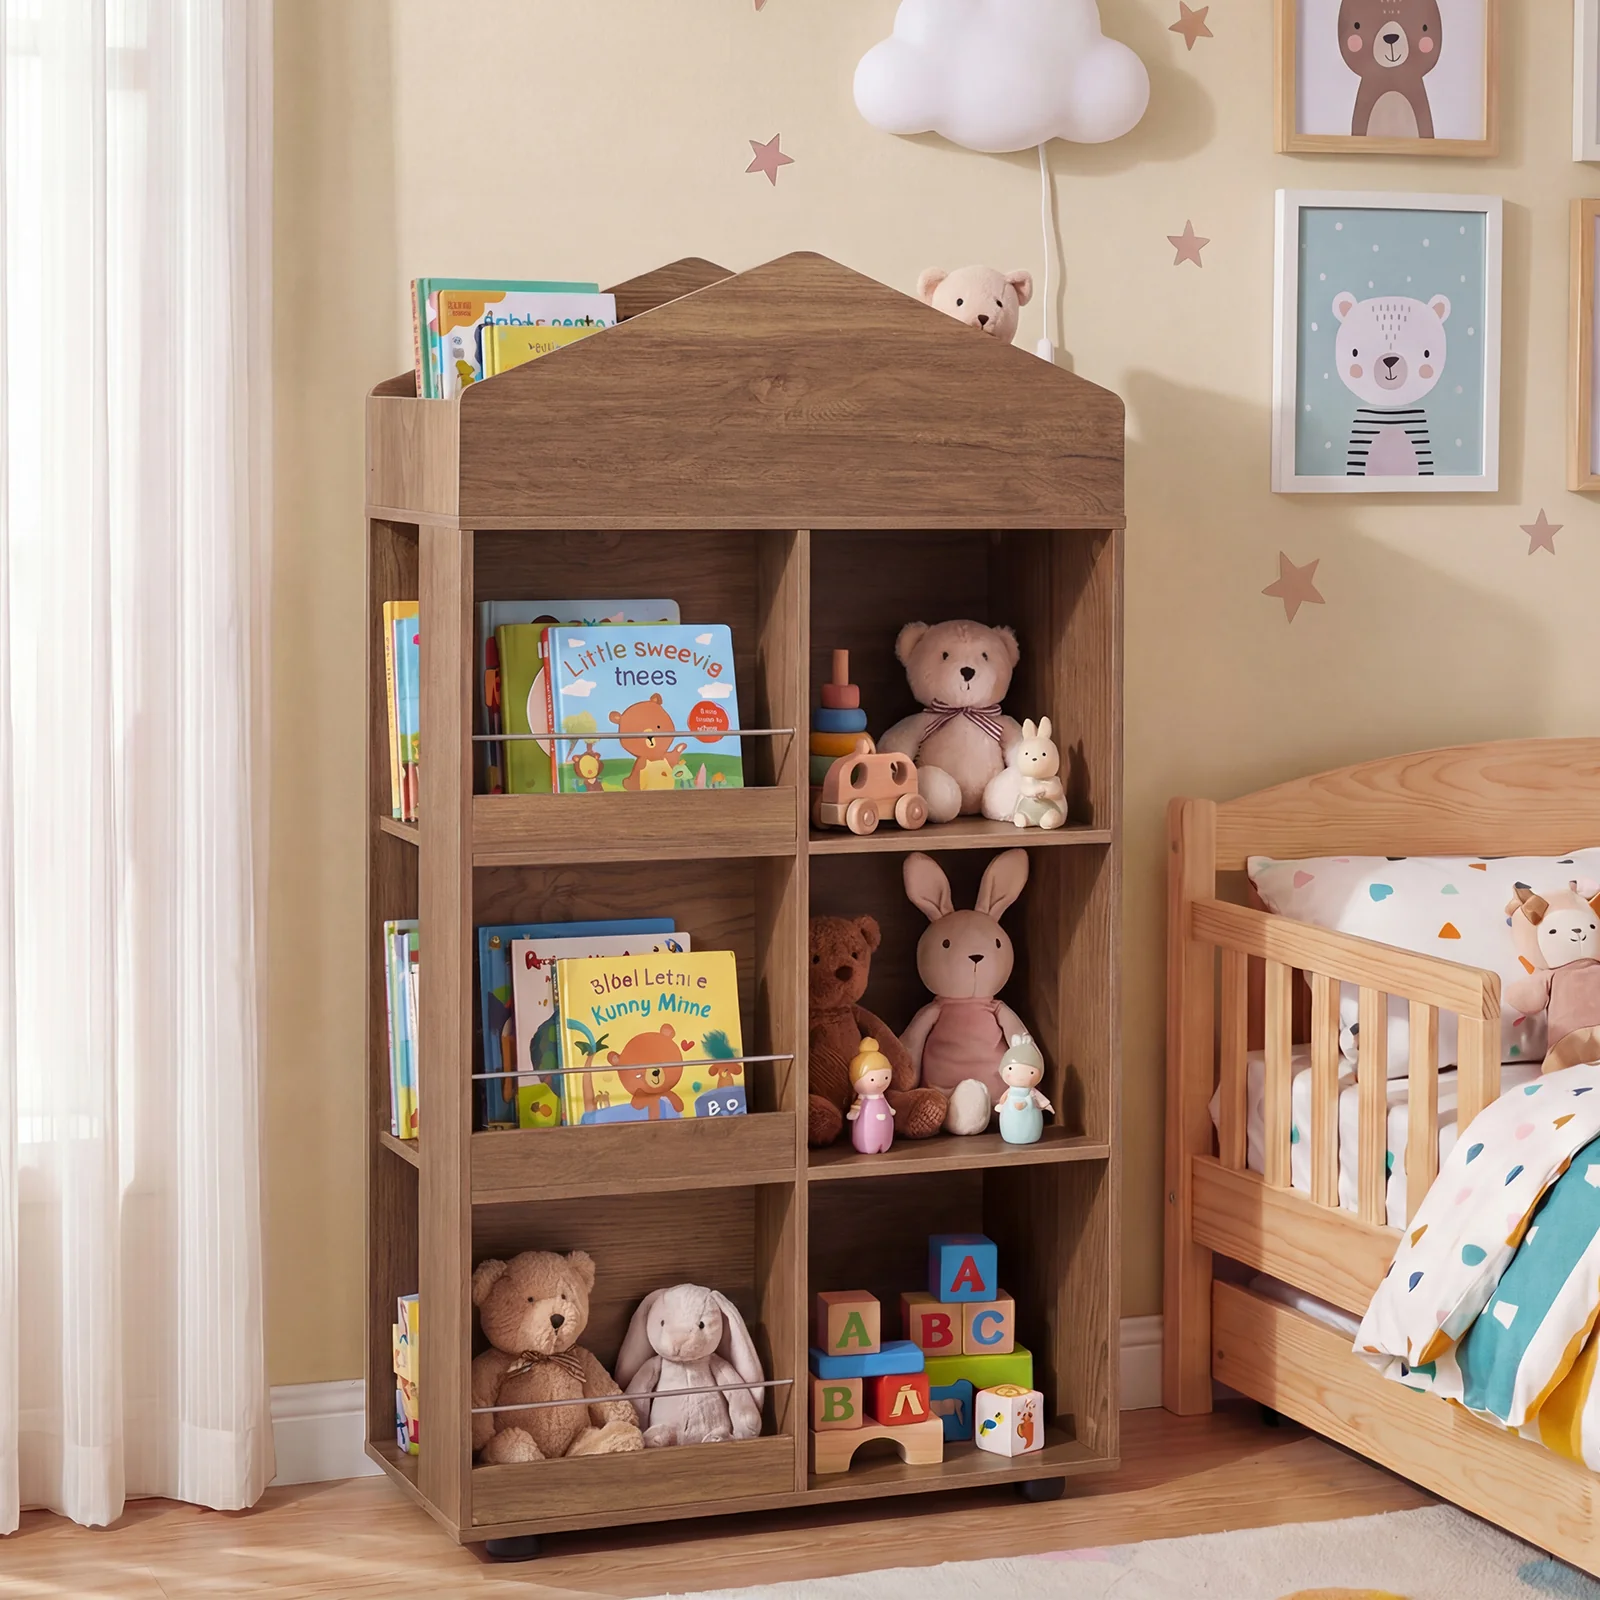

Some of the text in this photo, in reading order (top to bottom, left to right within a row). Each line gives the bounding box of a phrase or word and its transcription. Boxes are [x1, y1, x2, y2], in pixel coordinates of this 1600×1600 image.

[563, 641, 627, 678] Little
[614, 666, 678, 687] tnees
[591, 999, 651, 1026] Kunny
[950, 1255, 986, 1293] A
[835, 1311, 873, 1349] A
[920, 1309, 1005, 1349] B C
[820, 1386, 855, 1423] B
